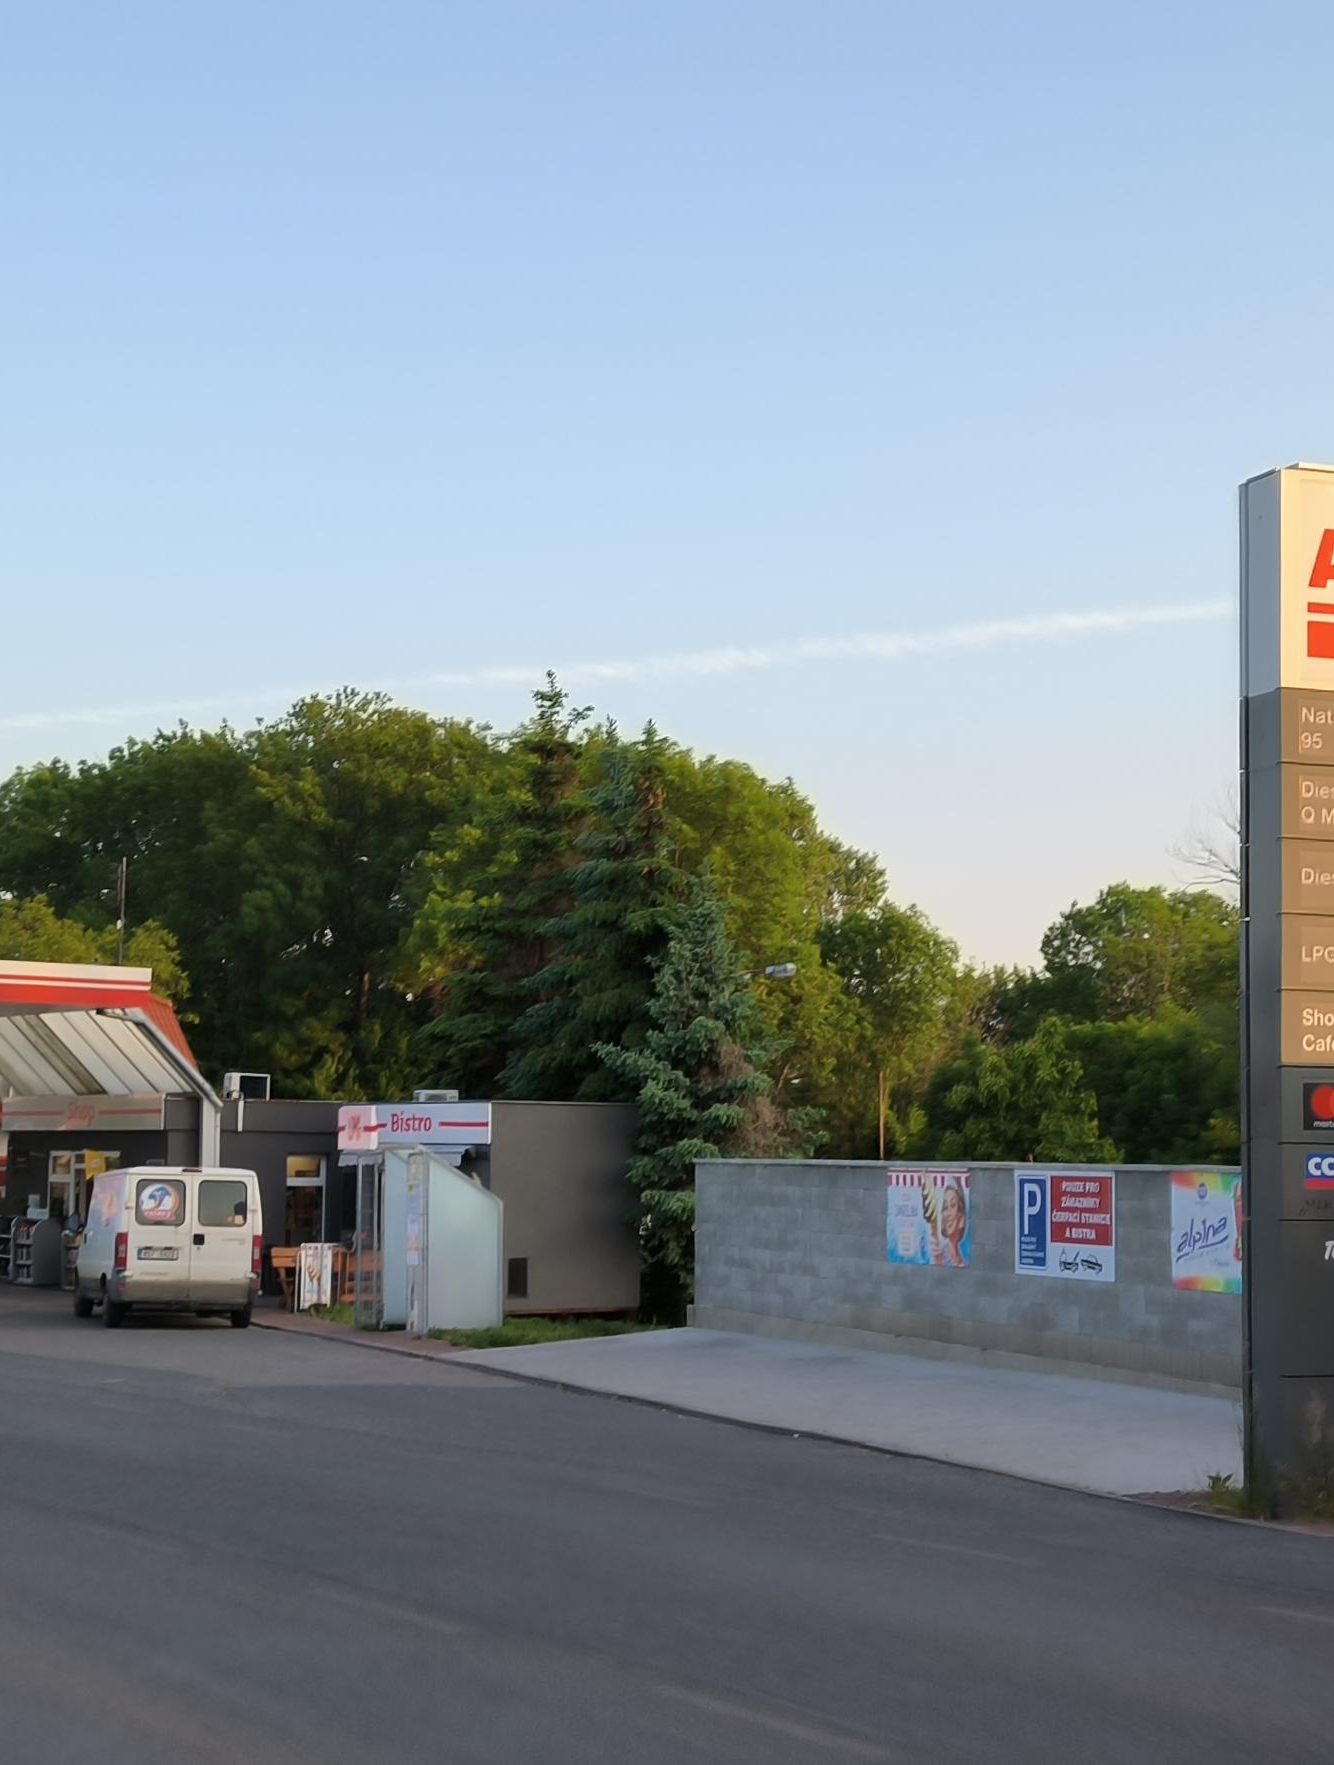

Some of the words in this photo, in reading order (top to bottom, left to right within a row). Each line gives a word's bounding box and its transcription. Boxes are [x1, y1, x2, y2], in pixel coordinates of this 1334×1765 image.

[1301, 732, 1323, 749] 95
[1301, 806, 1316, 824] Q
[391, 1111, 432, 1132] Bistro
[1024, 1183, 1042, 1235] P
